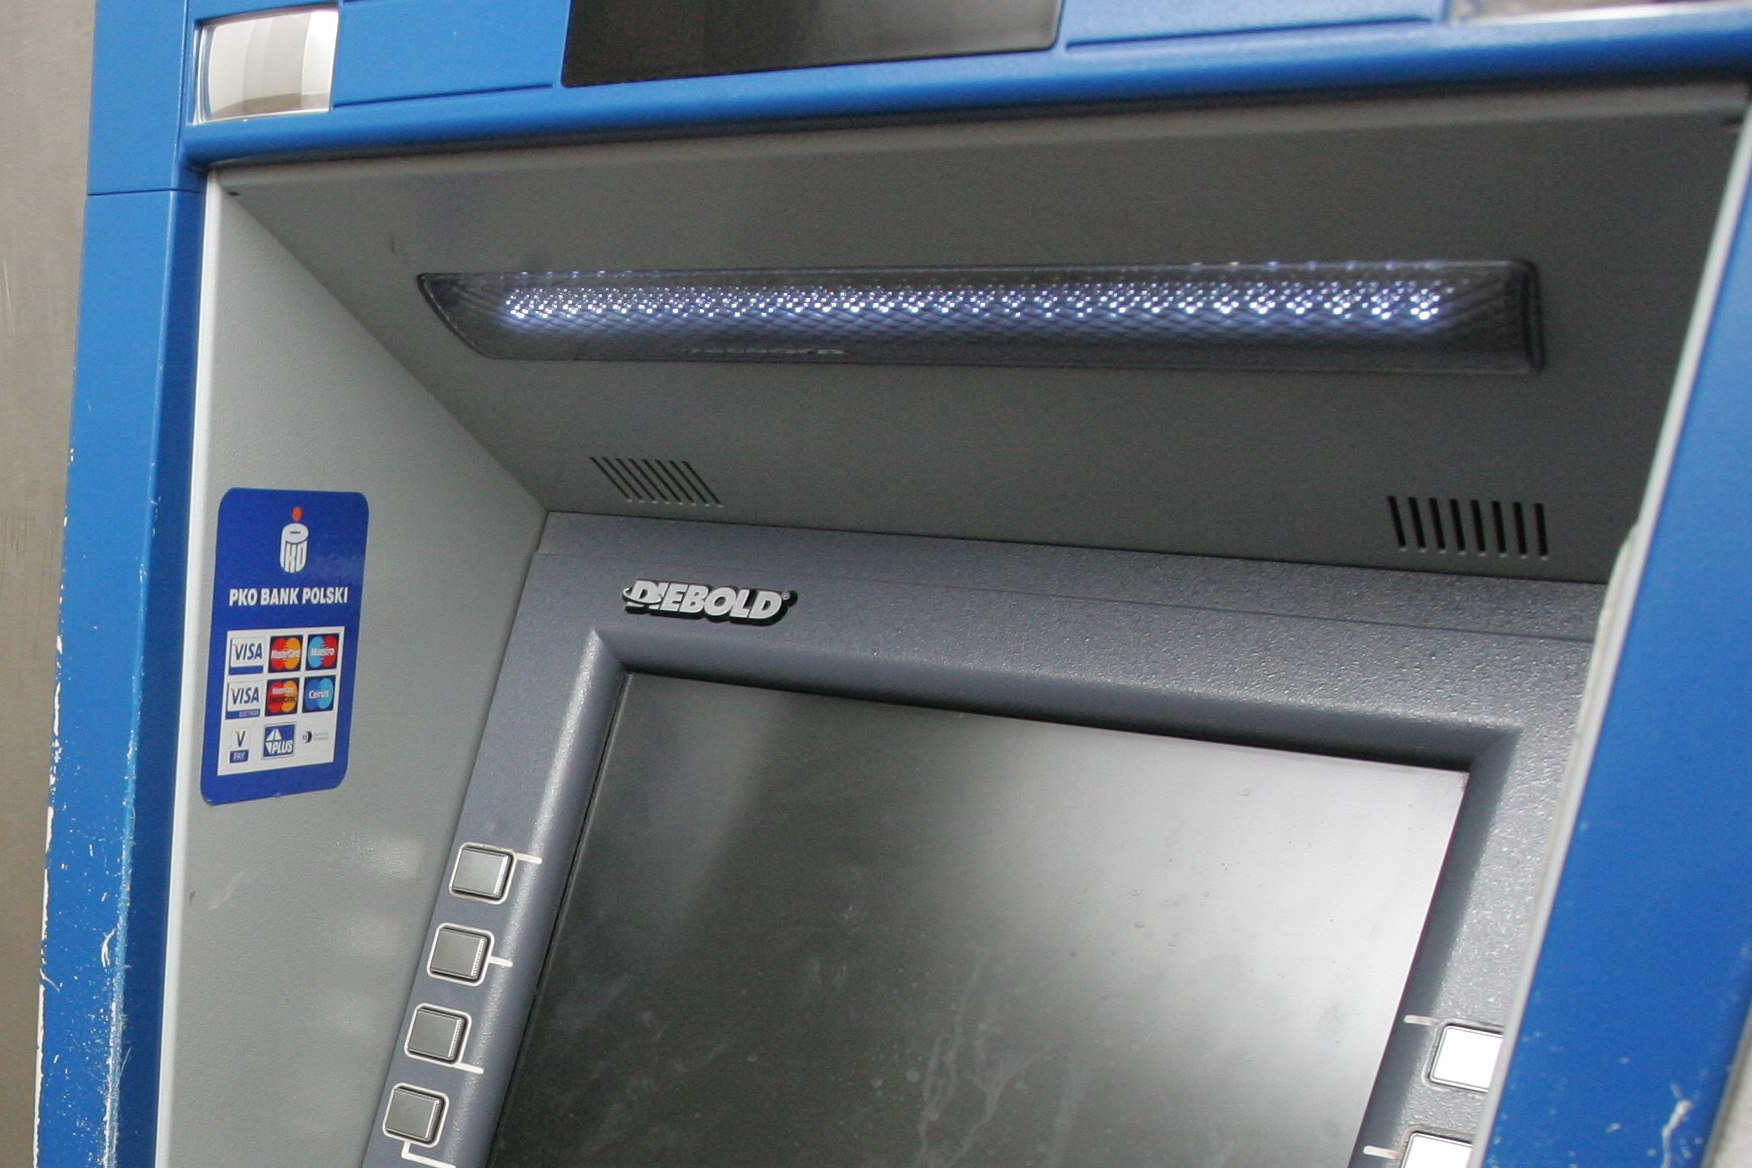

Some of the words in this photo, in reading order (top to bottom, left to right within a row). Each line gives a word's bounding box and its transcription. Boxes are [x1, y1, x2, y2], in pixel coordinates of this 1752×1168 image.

[229, 588, 258, 606] PKO
[260, 587, 300, 606] BANK
[302, 586, 348, 605] POLSKI
[622, 580, 783, 620] DIEBOLD
[233, 642, 263, 661] VISA
[230, 686, 260, 705] VISA
[271, 739, 295, 756] PLUS
